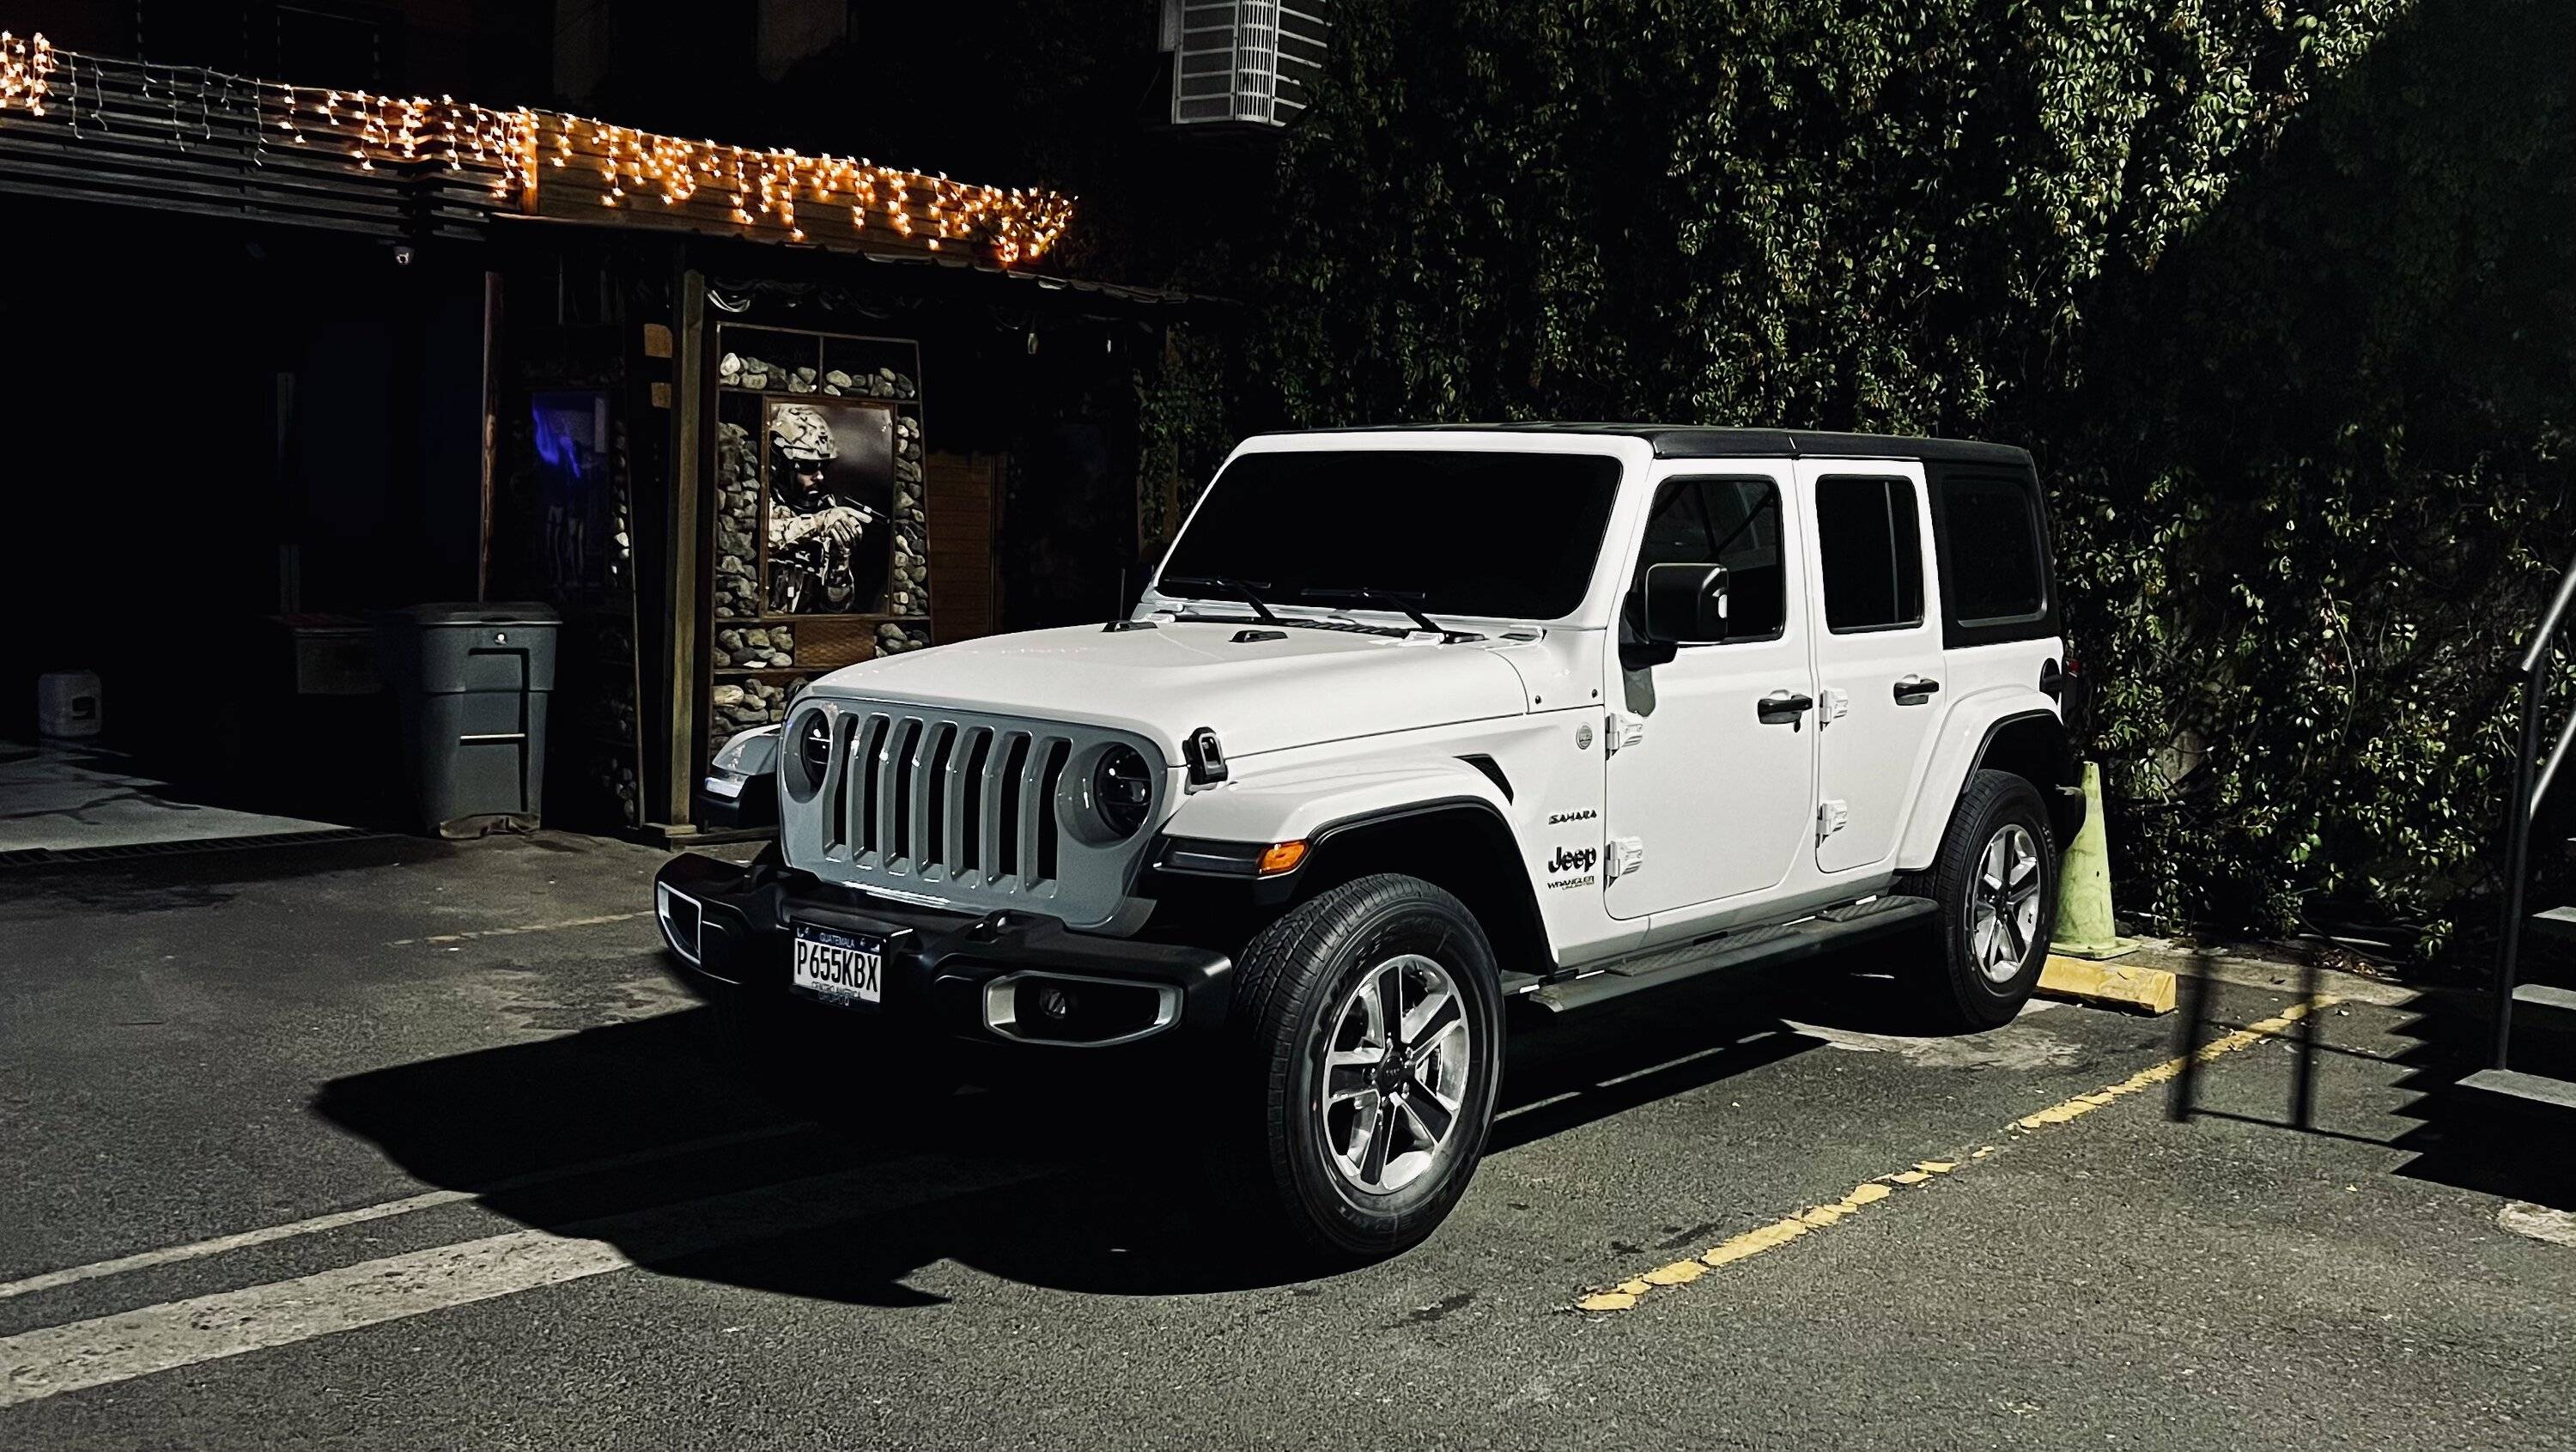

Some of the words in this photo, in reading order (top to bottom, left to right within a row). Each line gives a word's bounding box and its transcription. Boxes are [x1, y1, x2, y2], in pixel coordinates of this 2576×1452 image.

[1548, 810, 1597, 824] SAHARA
[1548, 847, 1597, 873] Jeep
[797, 940, 878, 993] P655KBX
